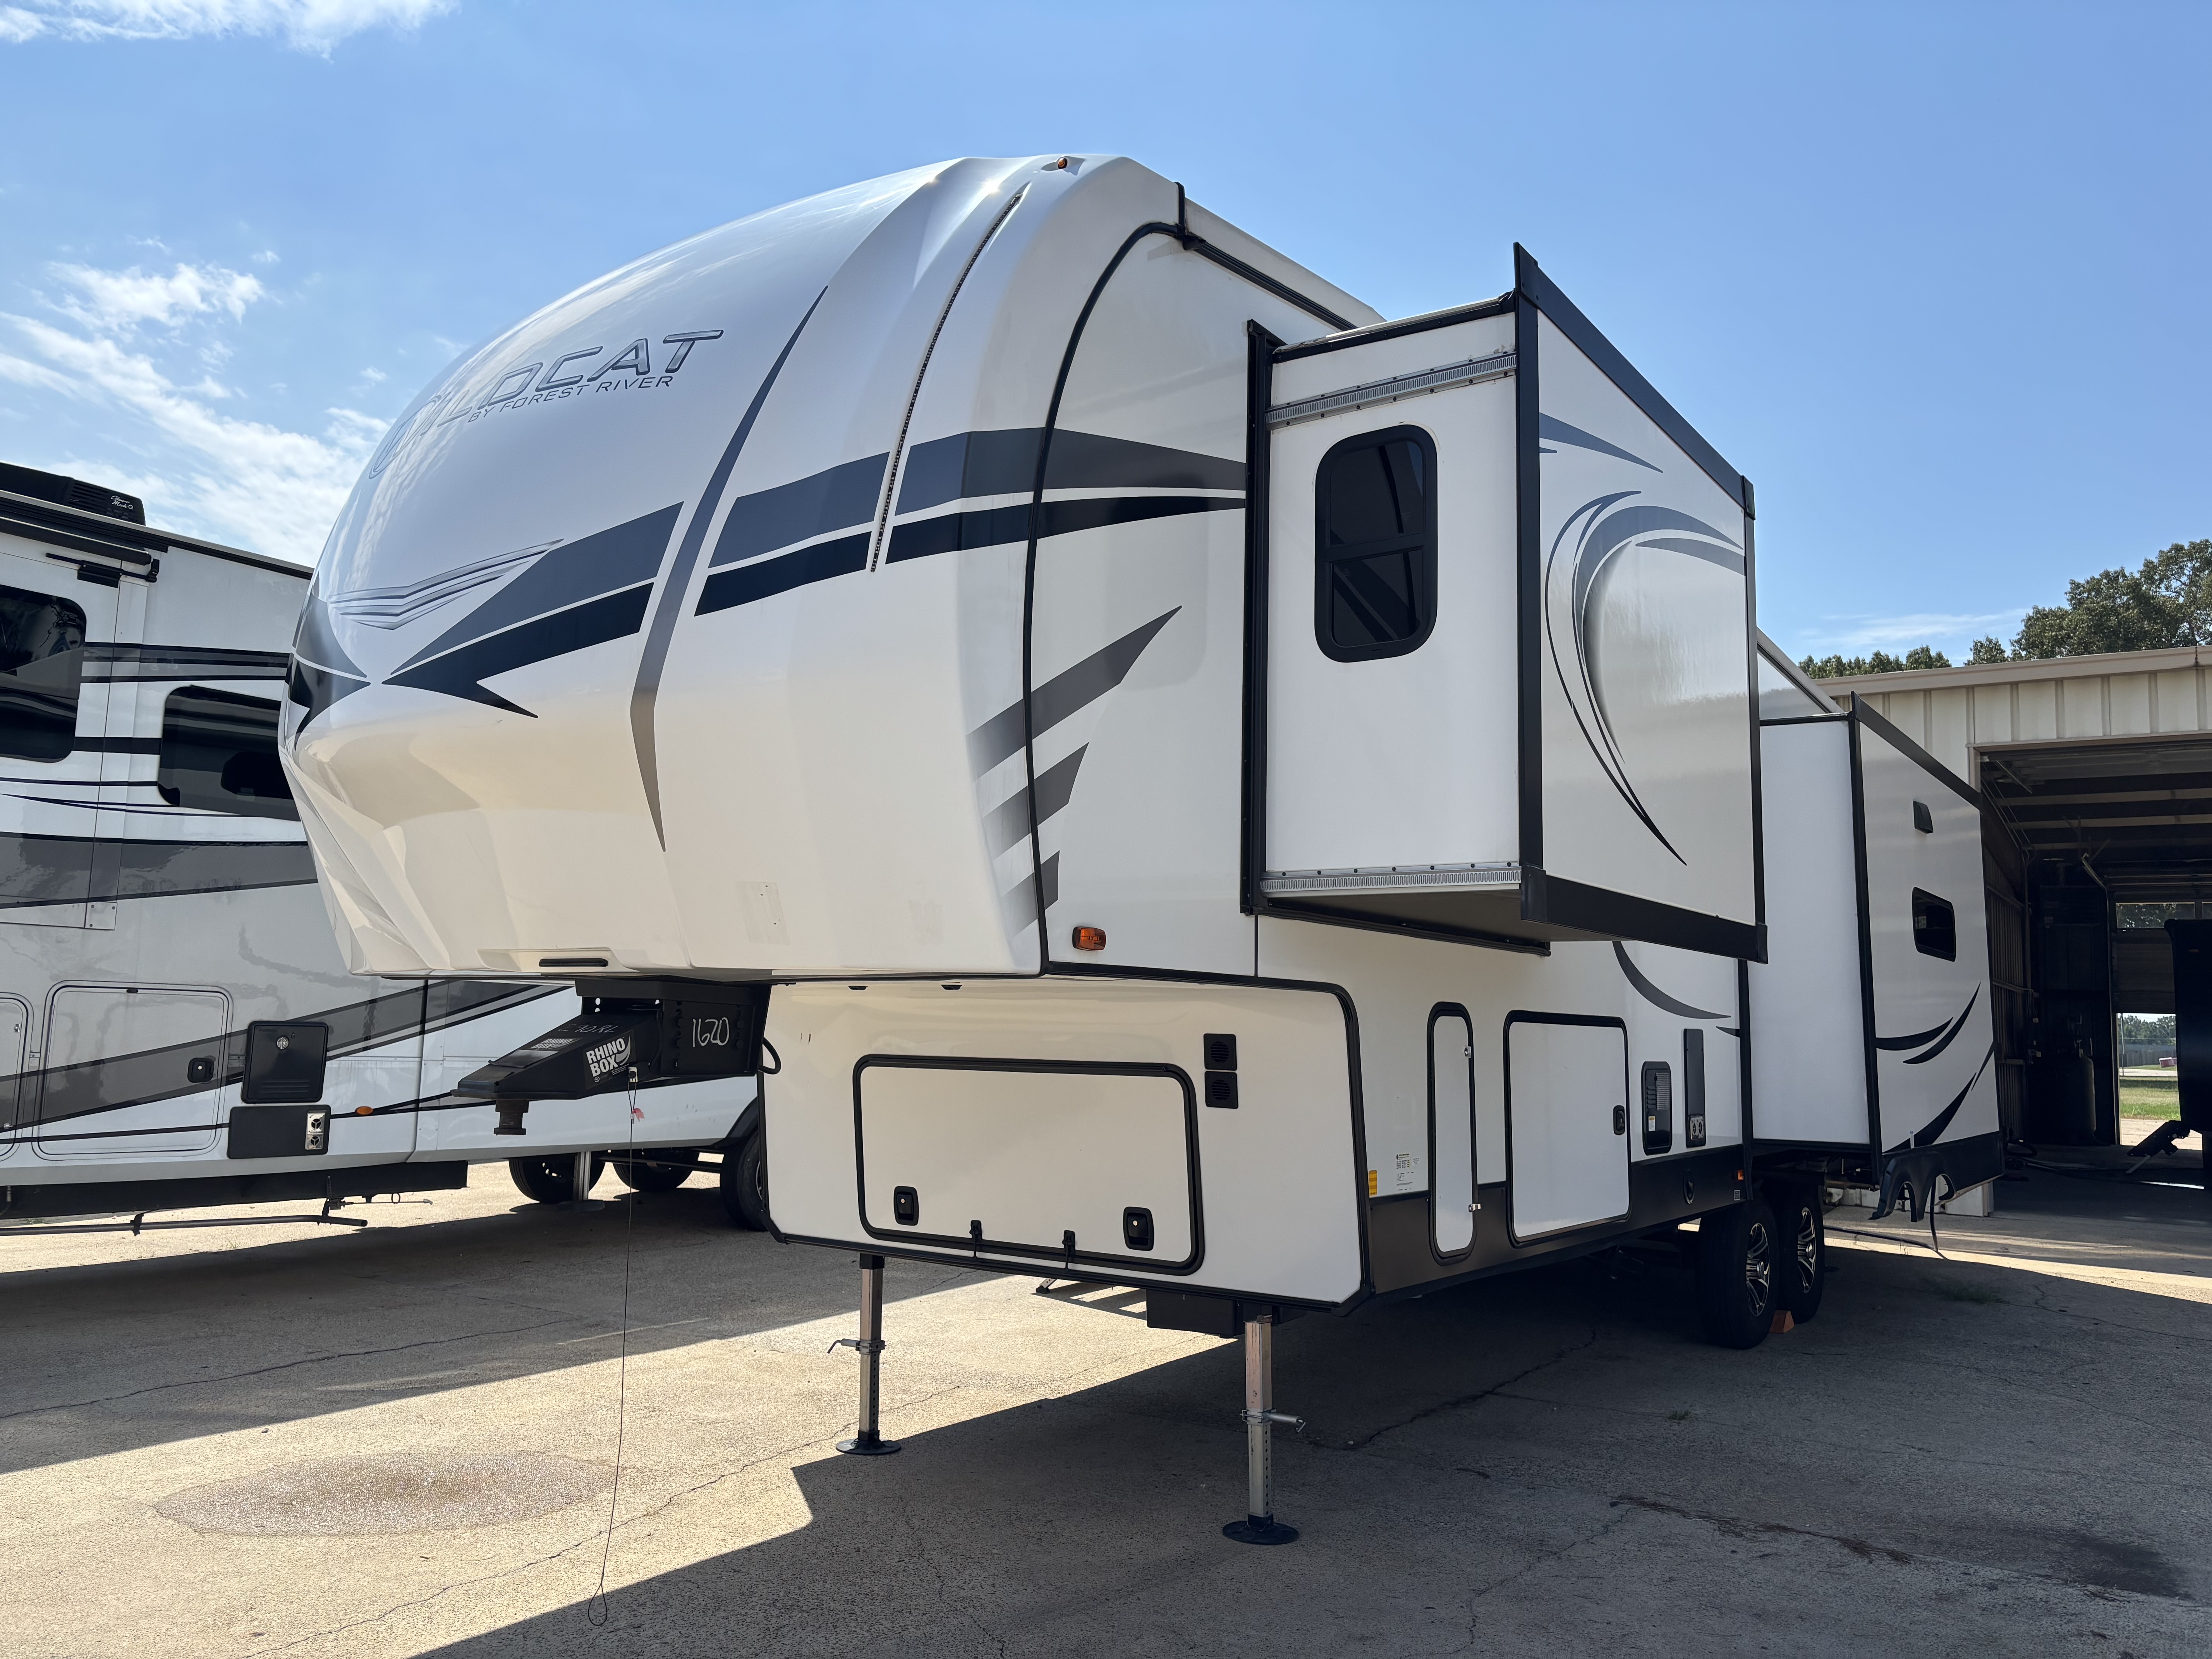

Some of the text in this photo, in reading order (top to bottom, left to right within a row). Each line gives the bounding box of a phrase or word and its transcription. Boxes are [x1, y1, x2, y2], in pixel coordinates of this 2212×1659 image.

[369, 330, 723, 479] WILDCAT
[467, 376, 673, 423] BY FOREST RIVER
[693, 1017, 729, 1048] 1620
[586, 1038, 625, 1064] RHINO
[590, 1054, 618, 1077] BOX
